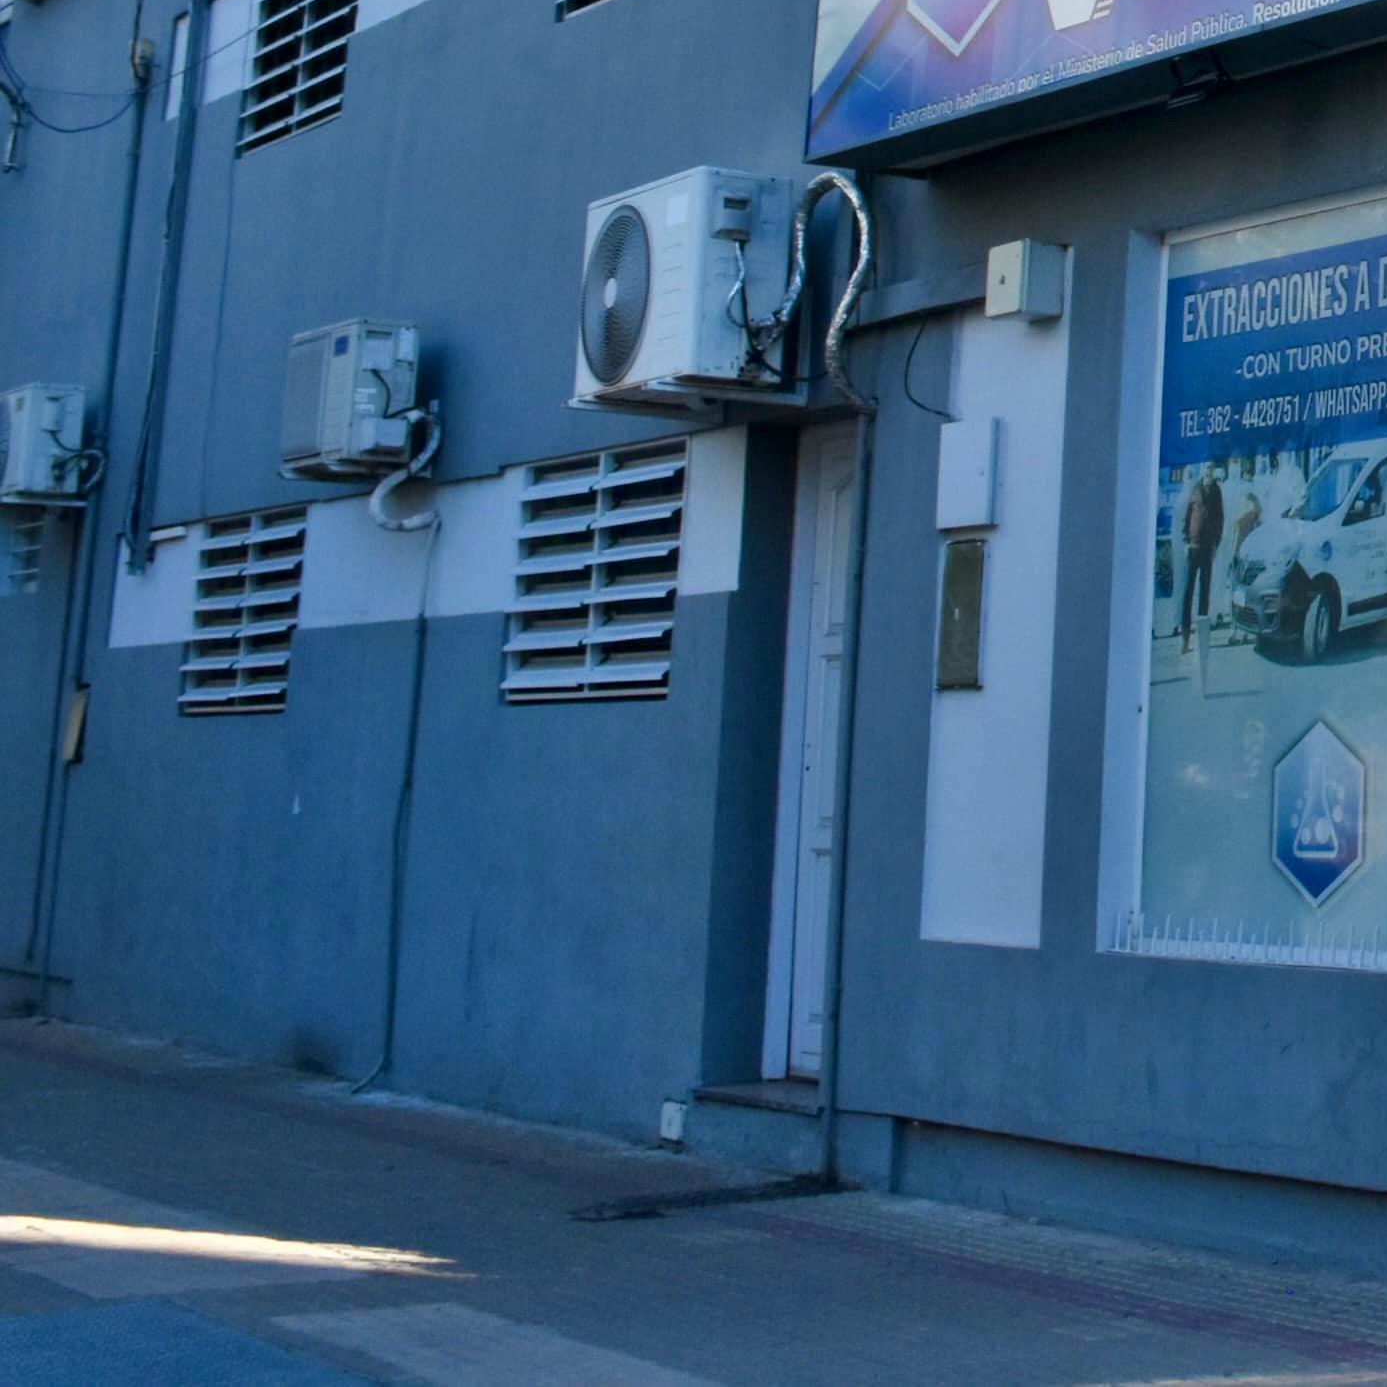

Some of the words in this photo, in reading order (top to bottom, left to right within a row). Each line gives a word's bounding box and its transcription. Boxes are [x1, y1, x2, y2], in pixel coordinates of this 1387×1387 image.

[1147, 27, 1186, 55] Salud
[1191, 15, 1248, 44] Pública.
[1182, 264, 1349, 343] EXTRACCIONES
[1354, 261, 1370, 313] A
[1285, 340, 1351, 372] TURNO
[1179, 409, 1204, 438] TEL:
[1207, 403, 1230, 434] 362
[1242, 394, 1299, 429] 4428751
